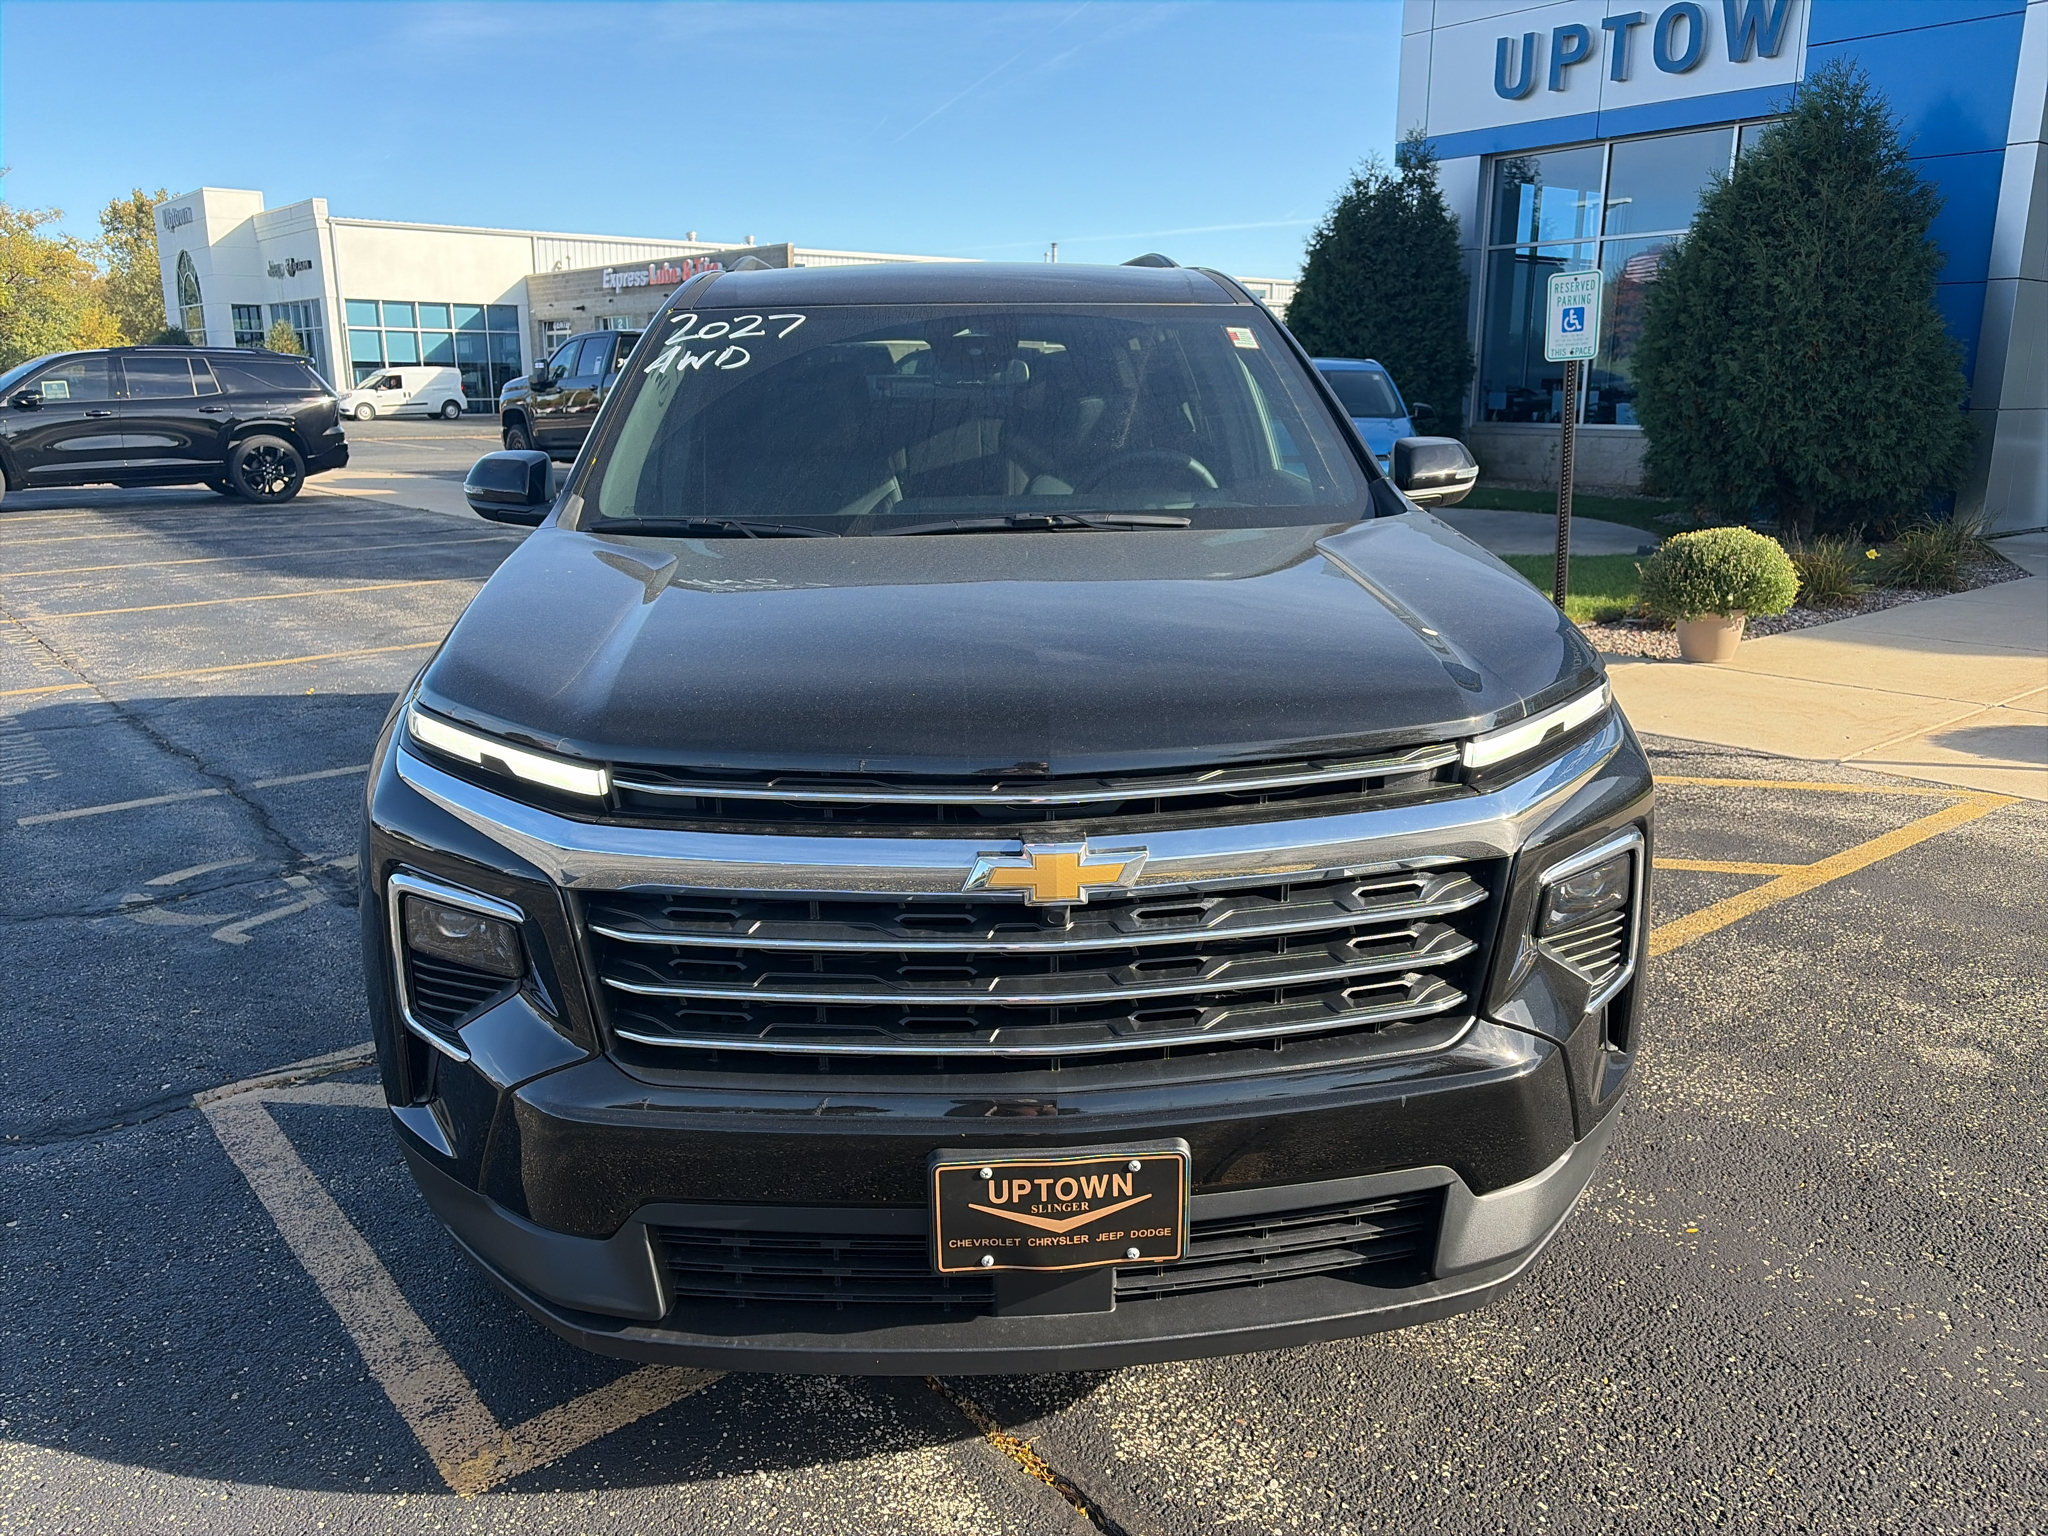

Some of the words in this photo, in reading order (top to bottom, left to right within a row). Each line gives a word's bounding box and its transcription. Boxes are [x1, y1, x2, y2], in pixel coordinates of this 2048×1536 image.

[1494, 0, 1794, 100] UPTOW
[162, 207, 193, 233] Uptown
[603, 268, 649, 293] Express
[649, 263, 681, 285] Lube
[682, 259, 696, 281] &
[1554, 280, 1596, 294] RESERVED
[1557, 293, 1592, 307] PARKING
[666, 313, 806, 345] 2027
[644, 345, 751, 374] AWD
[1551, 348, 1567, 357] THIS
[988, 1173, 1133, 1204] UPTOWN
[1031, 1202, 1090, 1214] SLINGER
[949, 1238, 1021, 1248] CHEVROLET
[1027, 1234, 1089, 1247] CHRYSLER
[1095, 1231, 1124, 1242] JEEP
[1130, 1227, 1172, 1239] DODGE
